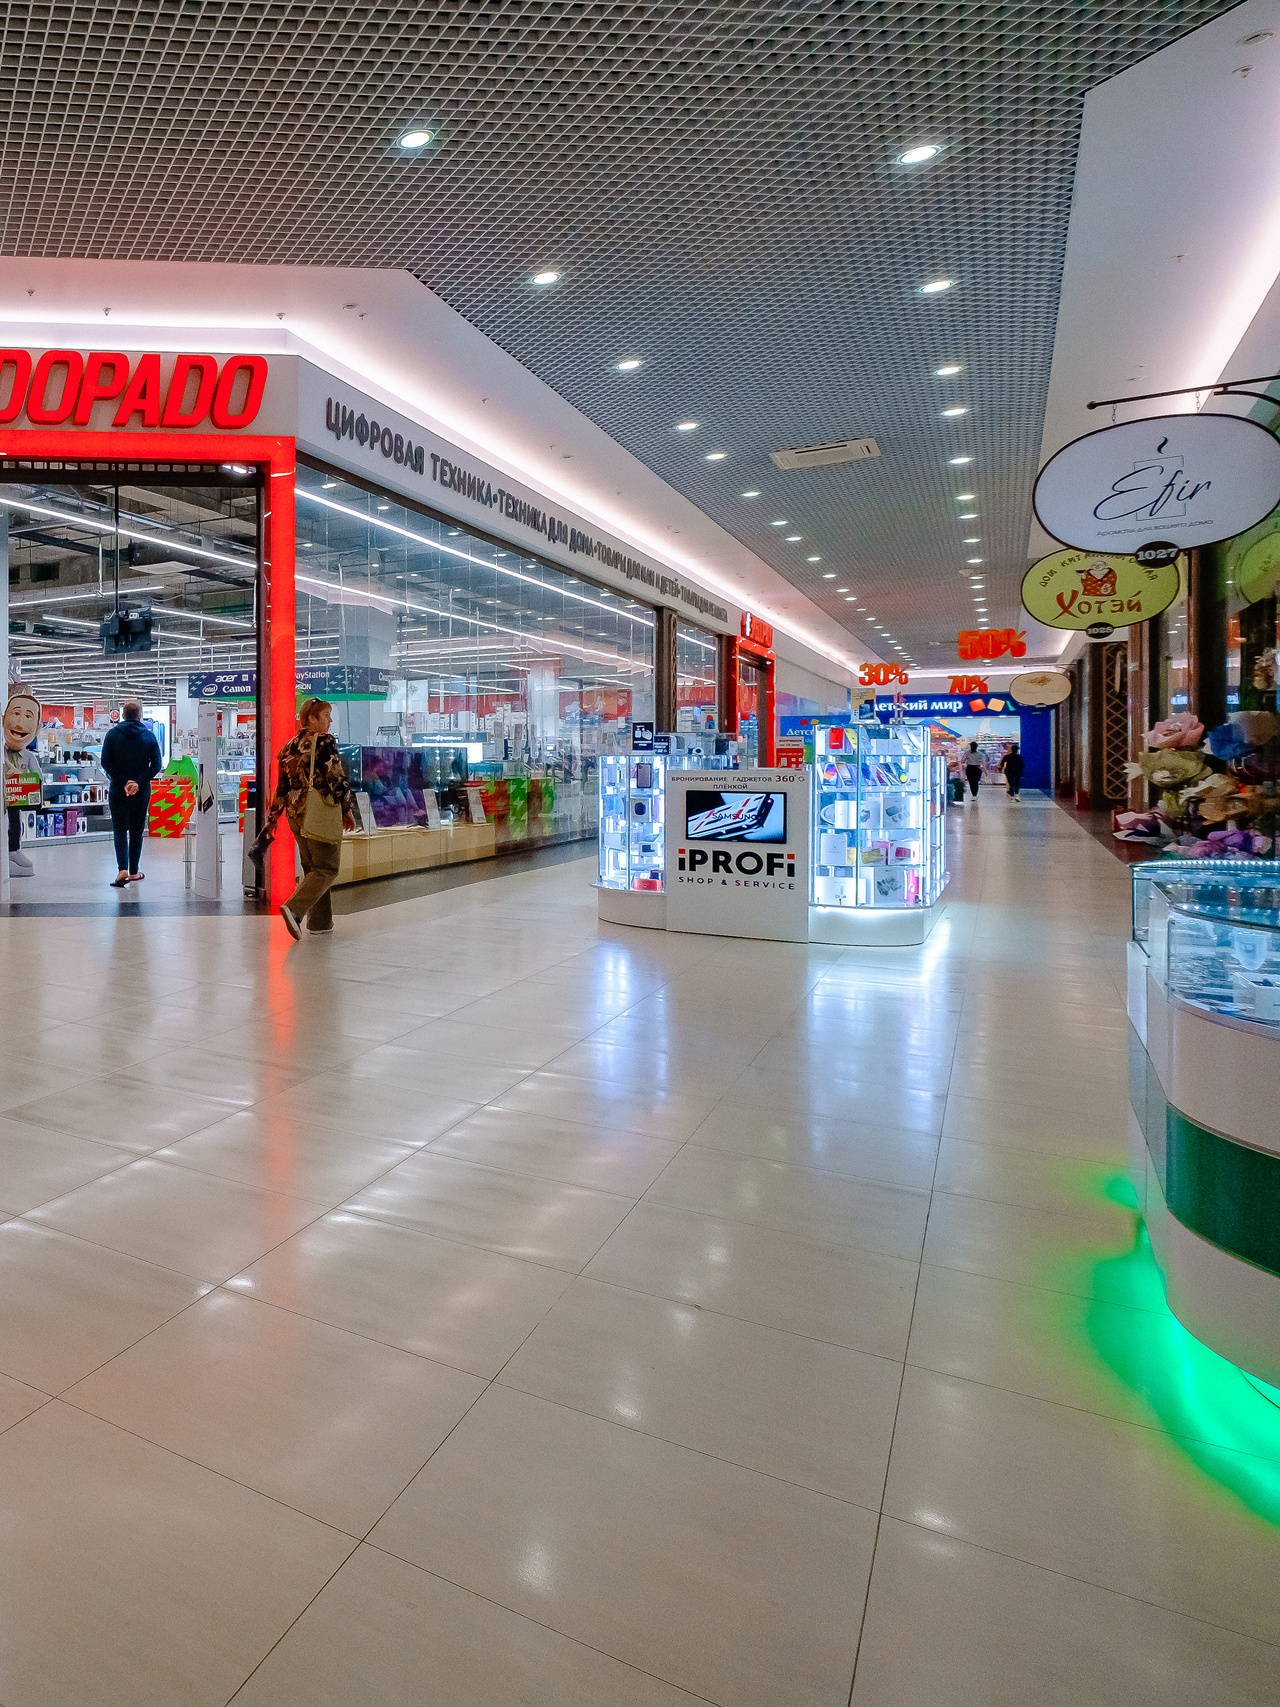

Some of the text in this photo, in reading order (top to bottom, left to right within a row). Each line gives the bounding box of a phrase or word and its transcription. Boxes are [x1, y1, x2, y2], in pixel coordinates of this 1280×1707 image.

[325, 396, 424, 475] ЦИФРОВАЯ
[431, 454, 494, 507] ТЕХНИКА
[497, 488, 548, 536] ТЕХНИКА
[548, 516, 568, 544] ДЛЯ
[569, 527, 594, 558] ДОМА
[1093, 465, 1211, 520] Efir
[1137, 548, 1180, 561] 1027
[958, 628, 1027, 660] 50%
[215, 674, 238, 683] acer
[295, 671, 330, 680] ayStation
[859, 663, 910, 686] 30%
[222, 685, 251, 693] Canon
[948, 675, 989, 694] 70%
[930, 701, 963, 712] мир
[678, 848, 795, 877] iPROFi
[679, 876, 713, 885] SHOP
[735, 880, 795, 890] SERVICE
